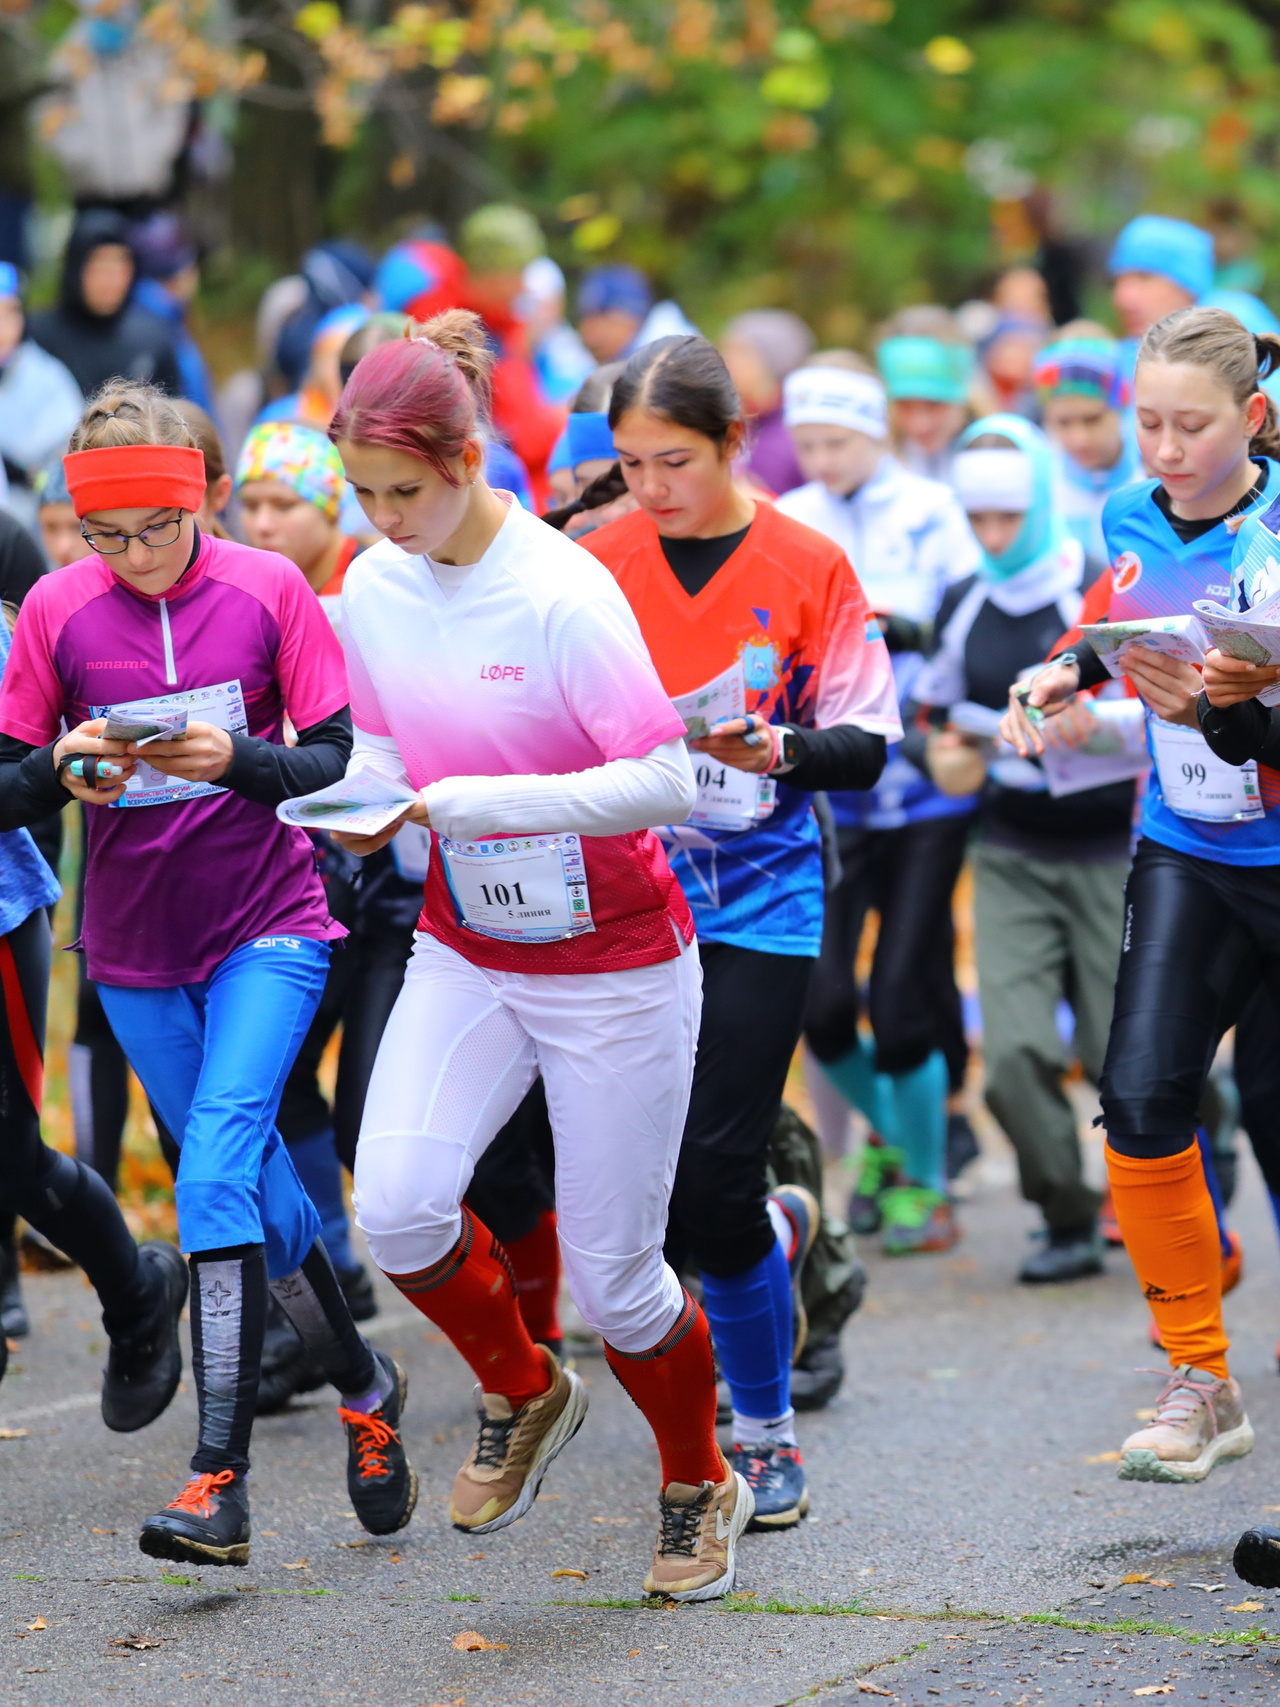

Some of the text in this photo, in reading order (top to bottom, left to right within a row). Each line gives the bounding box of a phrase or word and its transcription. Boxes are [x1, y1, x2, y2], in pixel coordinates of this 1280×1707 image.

[86, 660, 149, 670] noname
[480, 664, 525, 681] LØPE
[230, 718, 246, 729] evo
[1182, 762, 1207, 786] 99
[126, 788, 163, 800] ПЕРВЕНСТВО
[127, 792, 177, 806] ВСЕРОССИЙСКИ
[566, 873, 585, 882] evo
[479, 881, 527, 906] 101
[508, 910, 515, 919] 5
[517, 908, 552, 919] линия
